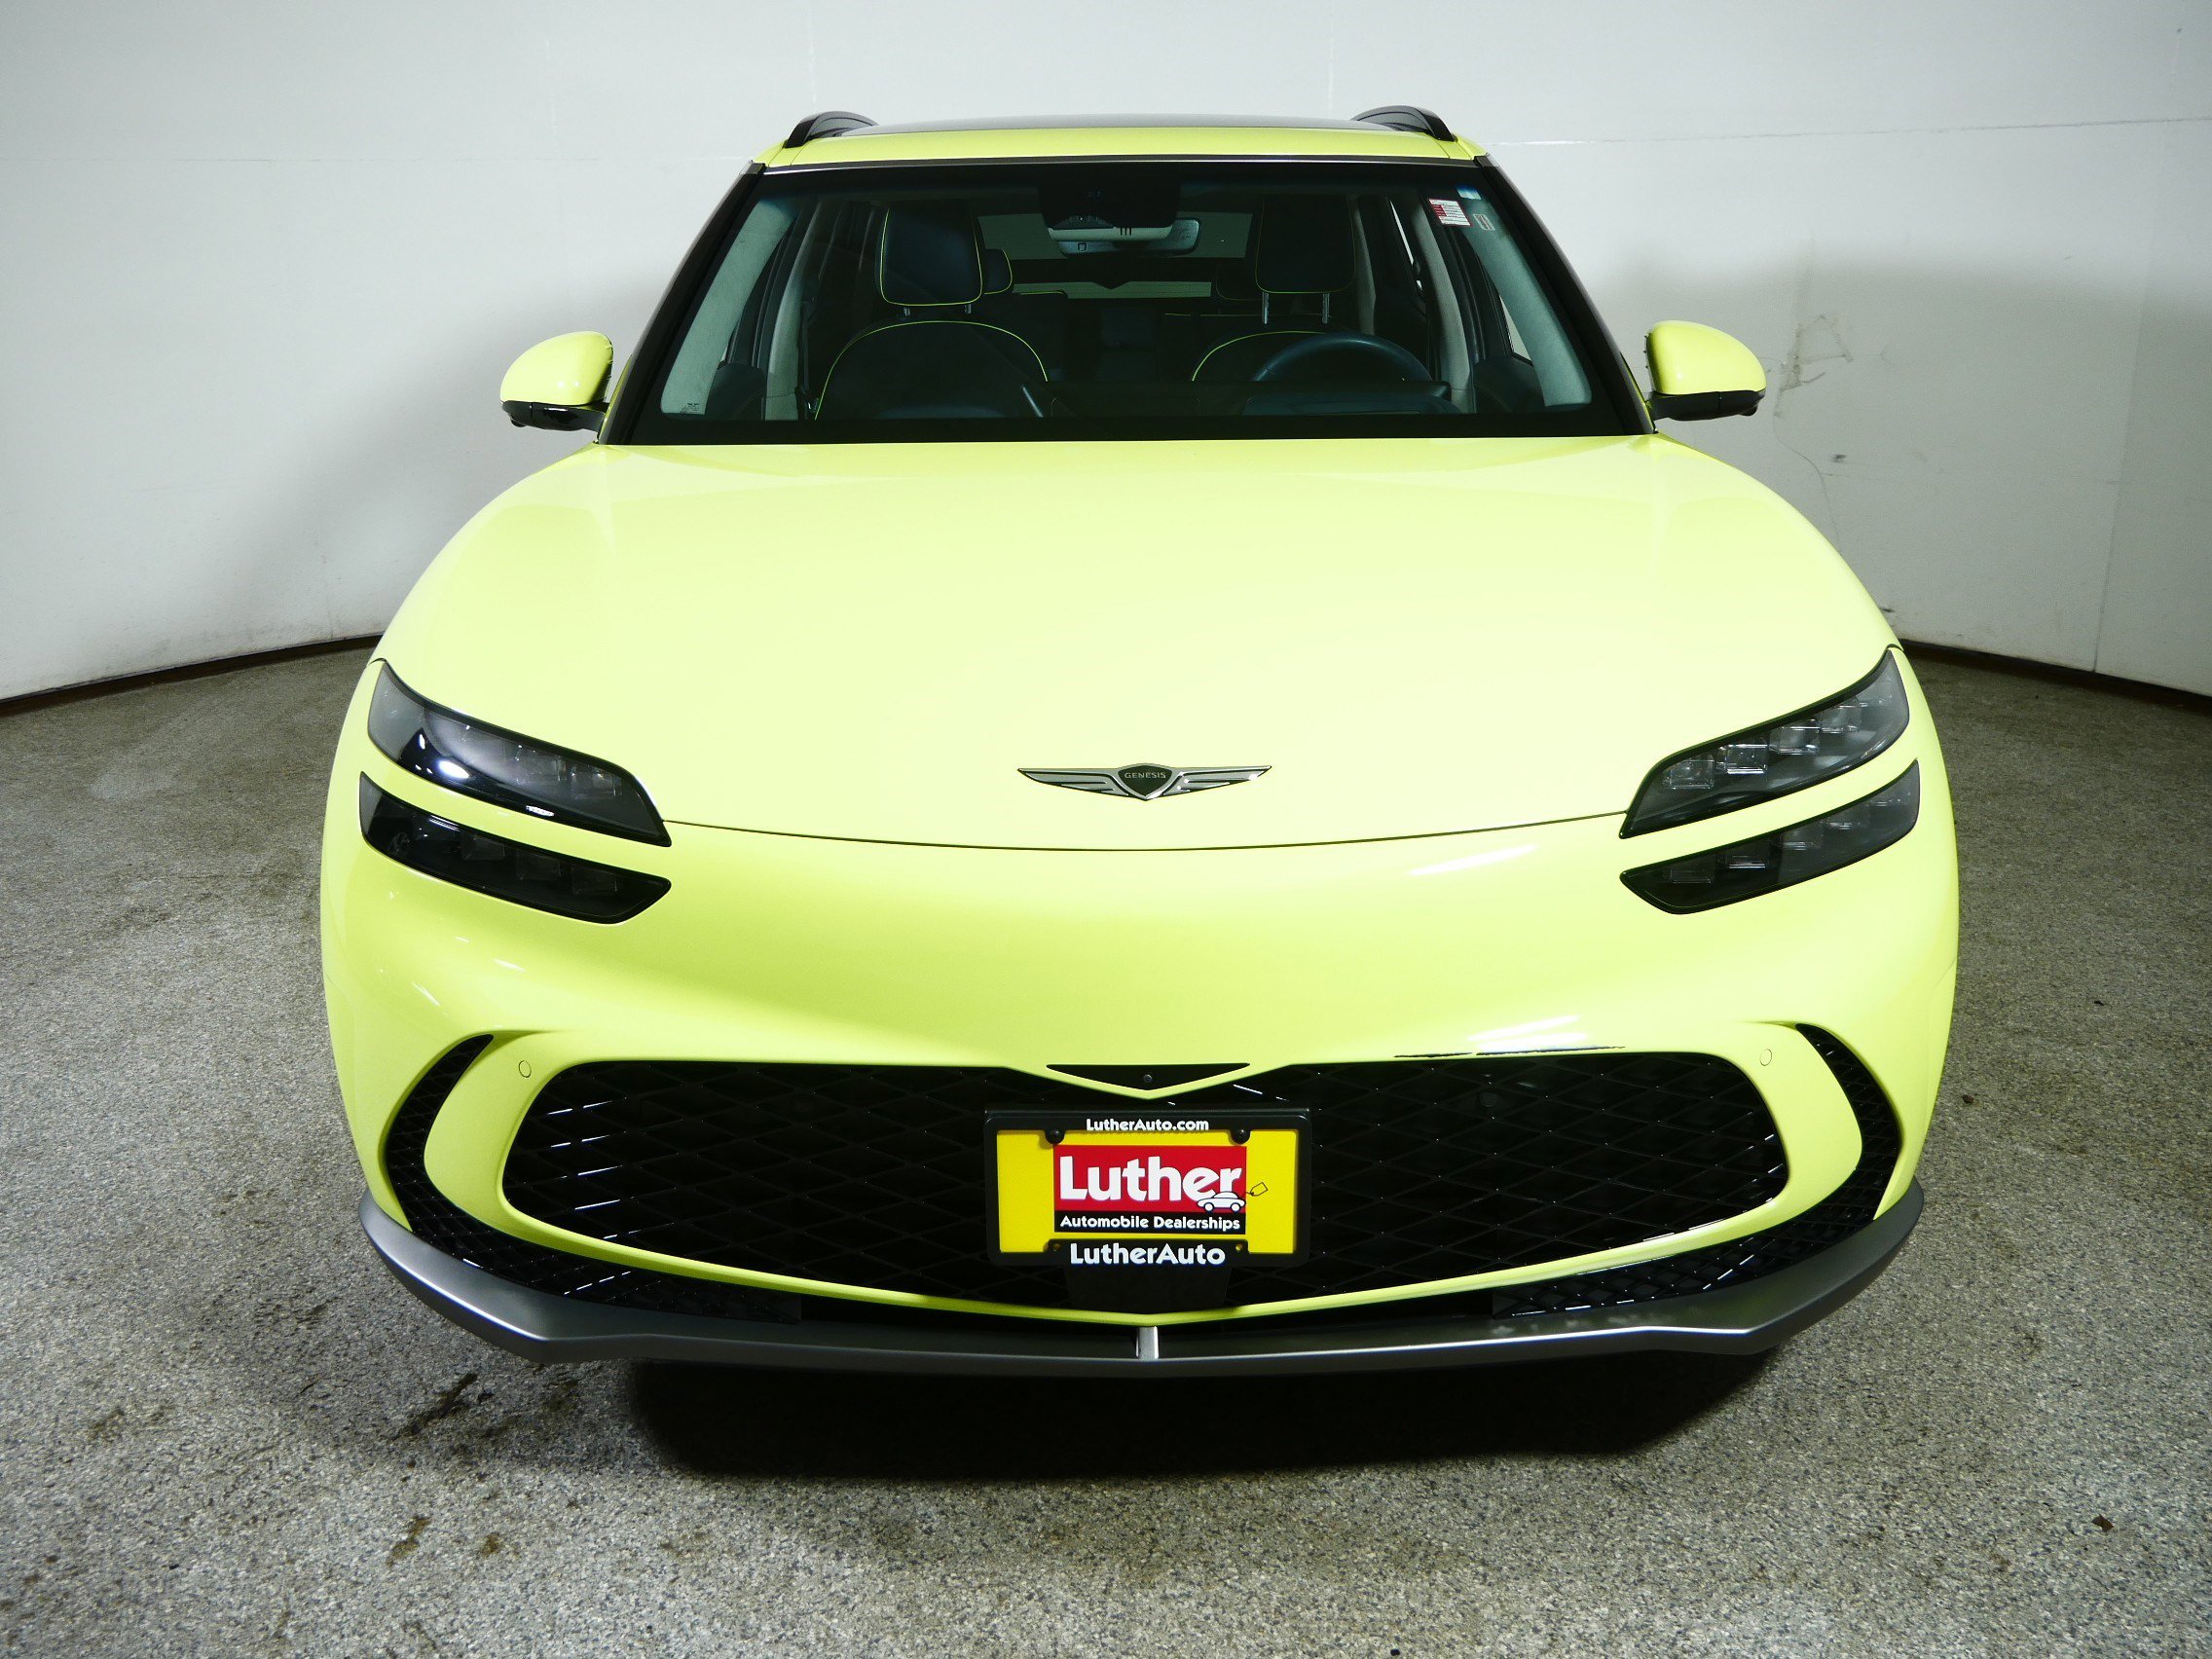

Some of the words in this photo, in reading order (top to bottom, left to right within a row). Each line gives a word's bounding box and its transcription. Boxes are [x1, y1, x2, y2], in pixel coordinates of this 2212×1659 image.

[1086, 1118, 1209, 1131] LutherAuto.com
[1059, 1156, 1242, 1202] Luther
[1059, 1215, 1149, 1229] Automobile
[1153, 1216, 1240, 1232] Dealerships
[1070, 1242, 1226, 1266] LutherAuto
